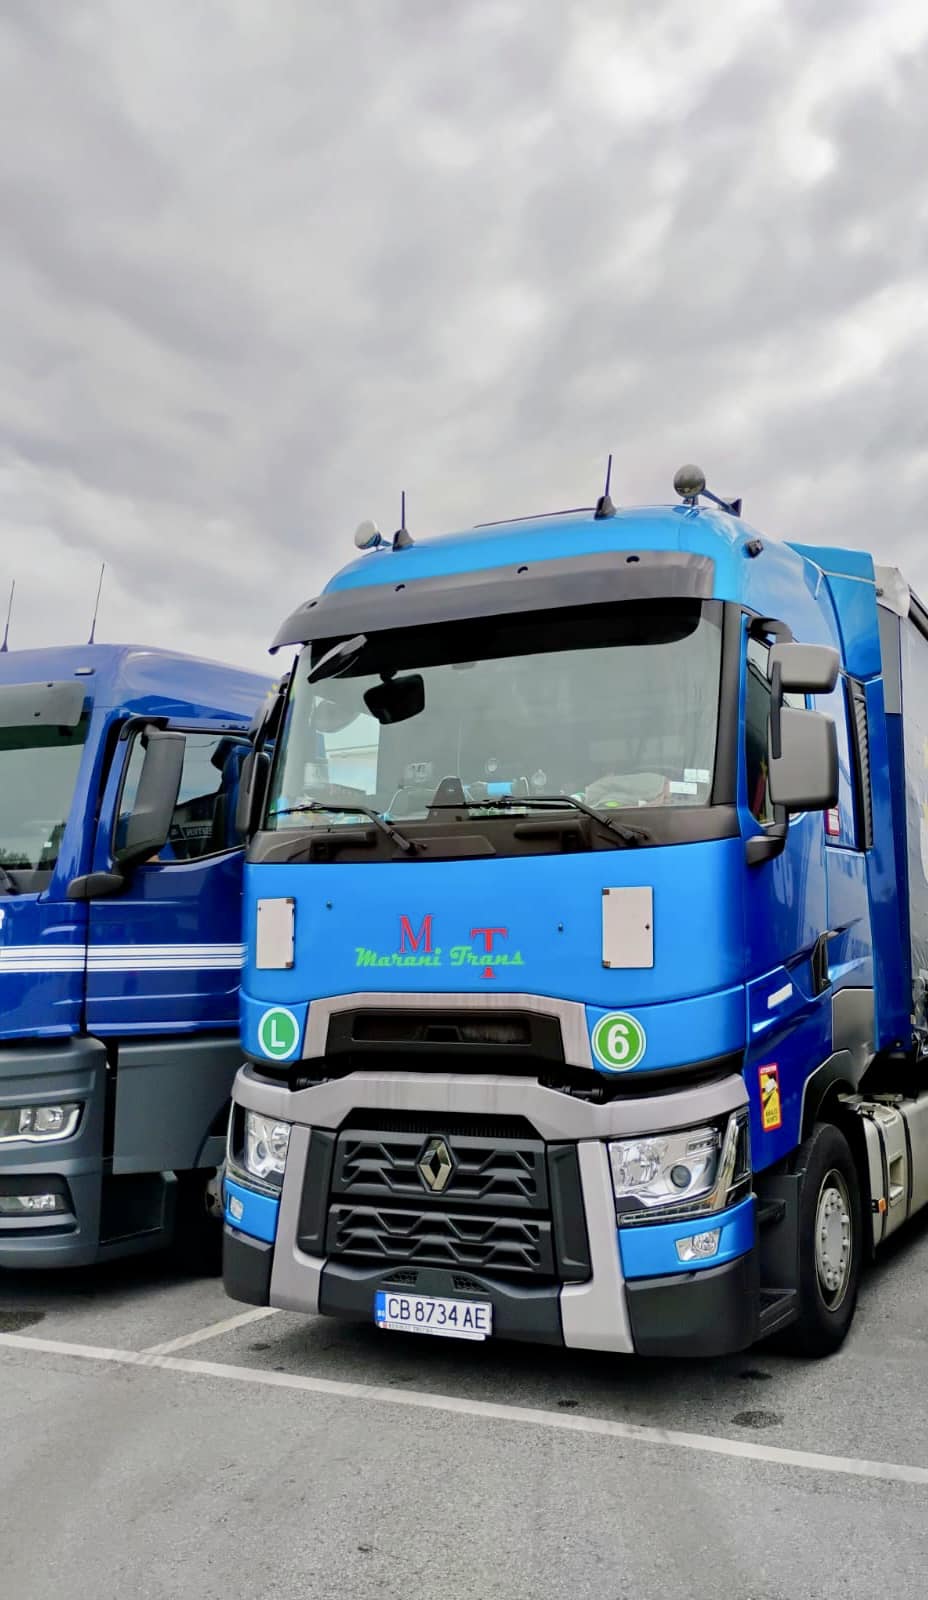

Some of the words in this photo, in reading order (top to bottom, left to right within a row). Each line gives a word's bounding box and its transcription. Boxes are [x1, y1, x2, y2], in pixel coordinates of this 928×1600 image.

[355, 947, 443, 967] Marani
[450, 945, 525, 967] Trans
[399, 914, 433, 953] M
[470, 927, 508, 979] T
[271, 1019, 286, 1048] L
[607, 1023, 630, 1060] 6
[388, 1298, 411, 1321] CB
[415, 1301, 458, 1326] 8734
[463, 1306, 487, 1330] AE
